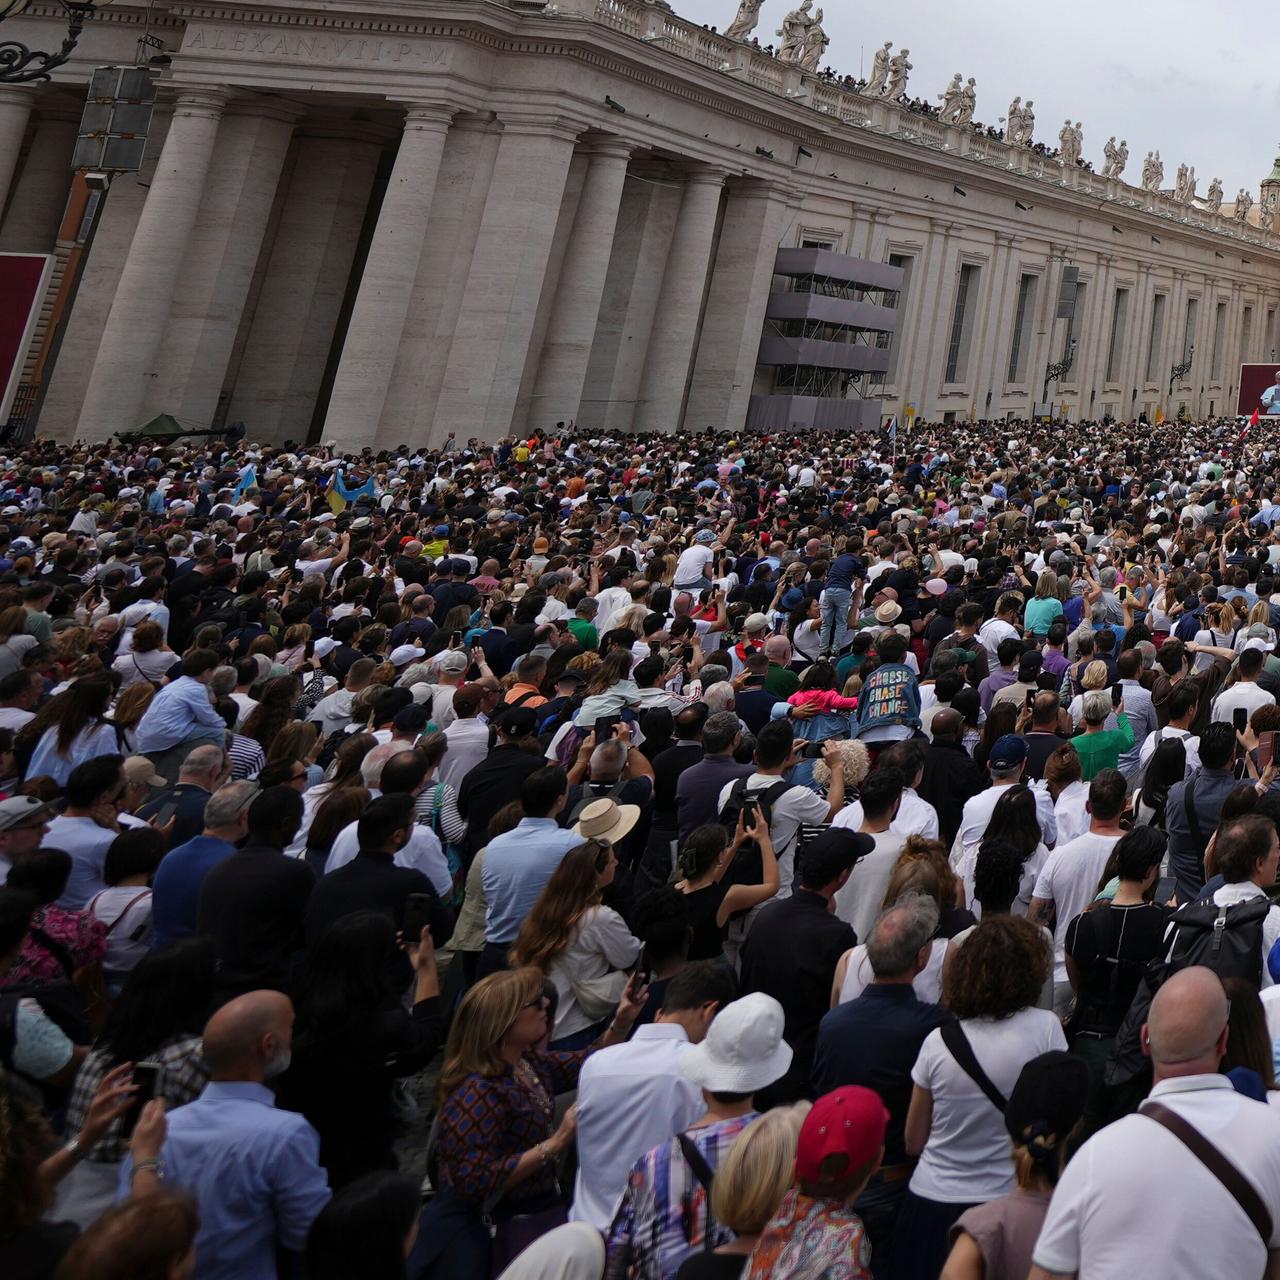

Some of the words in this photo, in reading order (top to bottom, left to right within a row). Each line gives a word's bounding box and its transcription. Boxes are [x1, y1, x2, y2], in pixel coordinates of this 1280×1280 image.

[186, 28, 318, 57] ALEXAN
[869, 670, 909, 689] CHOOSE
[869, 683, 907, 703] CHASE
[868, 699, 908, 718] CHANGE
